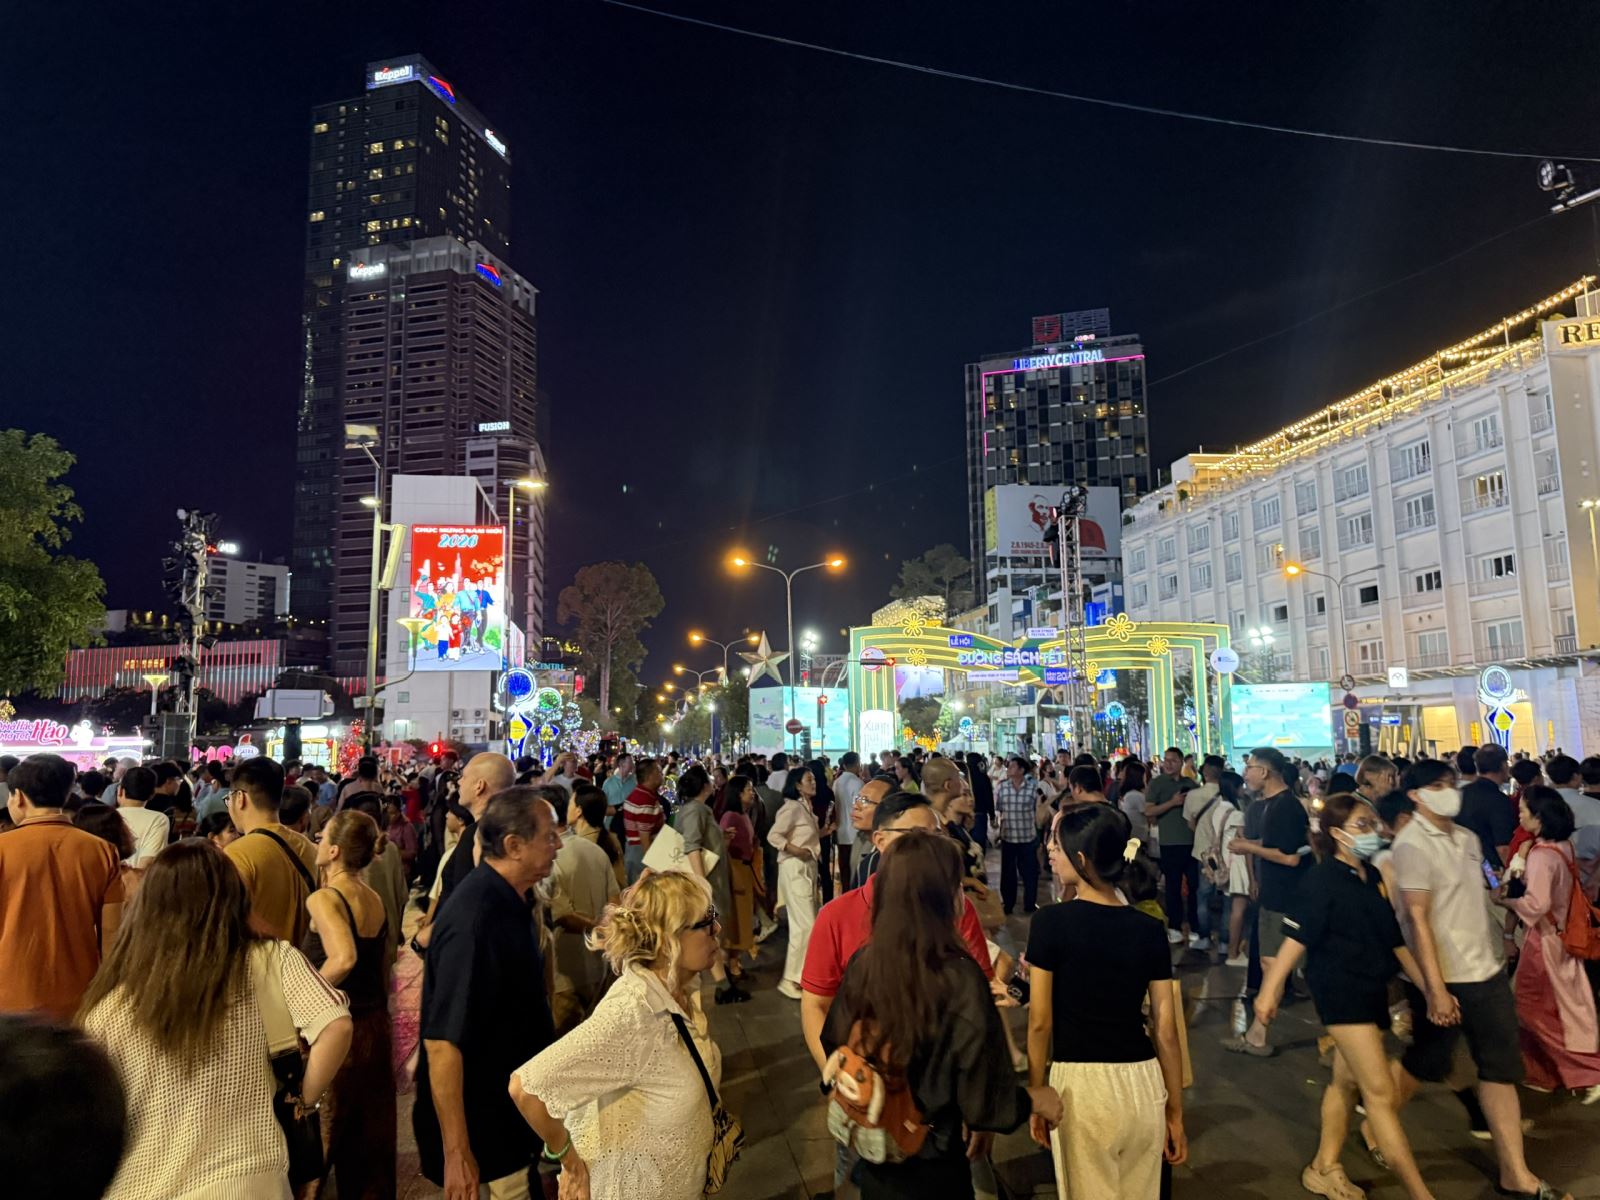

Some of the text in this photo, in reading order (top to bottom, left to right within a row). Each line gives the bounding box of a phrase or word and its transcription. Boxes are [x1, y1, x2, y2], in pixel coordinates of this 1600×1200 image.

[478, 421, 510, 432] FUSION
[437, 534, 479, 548] 2026
[1003, 647, 1040, 666] SÁCH
[1041, 646, 1065, 666] TẾT
